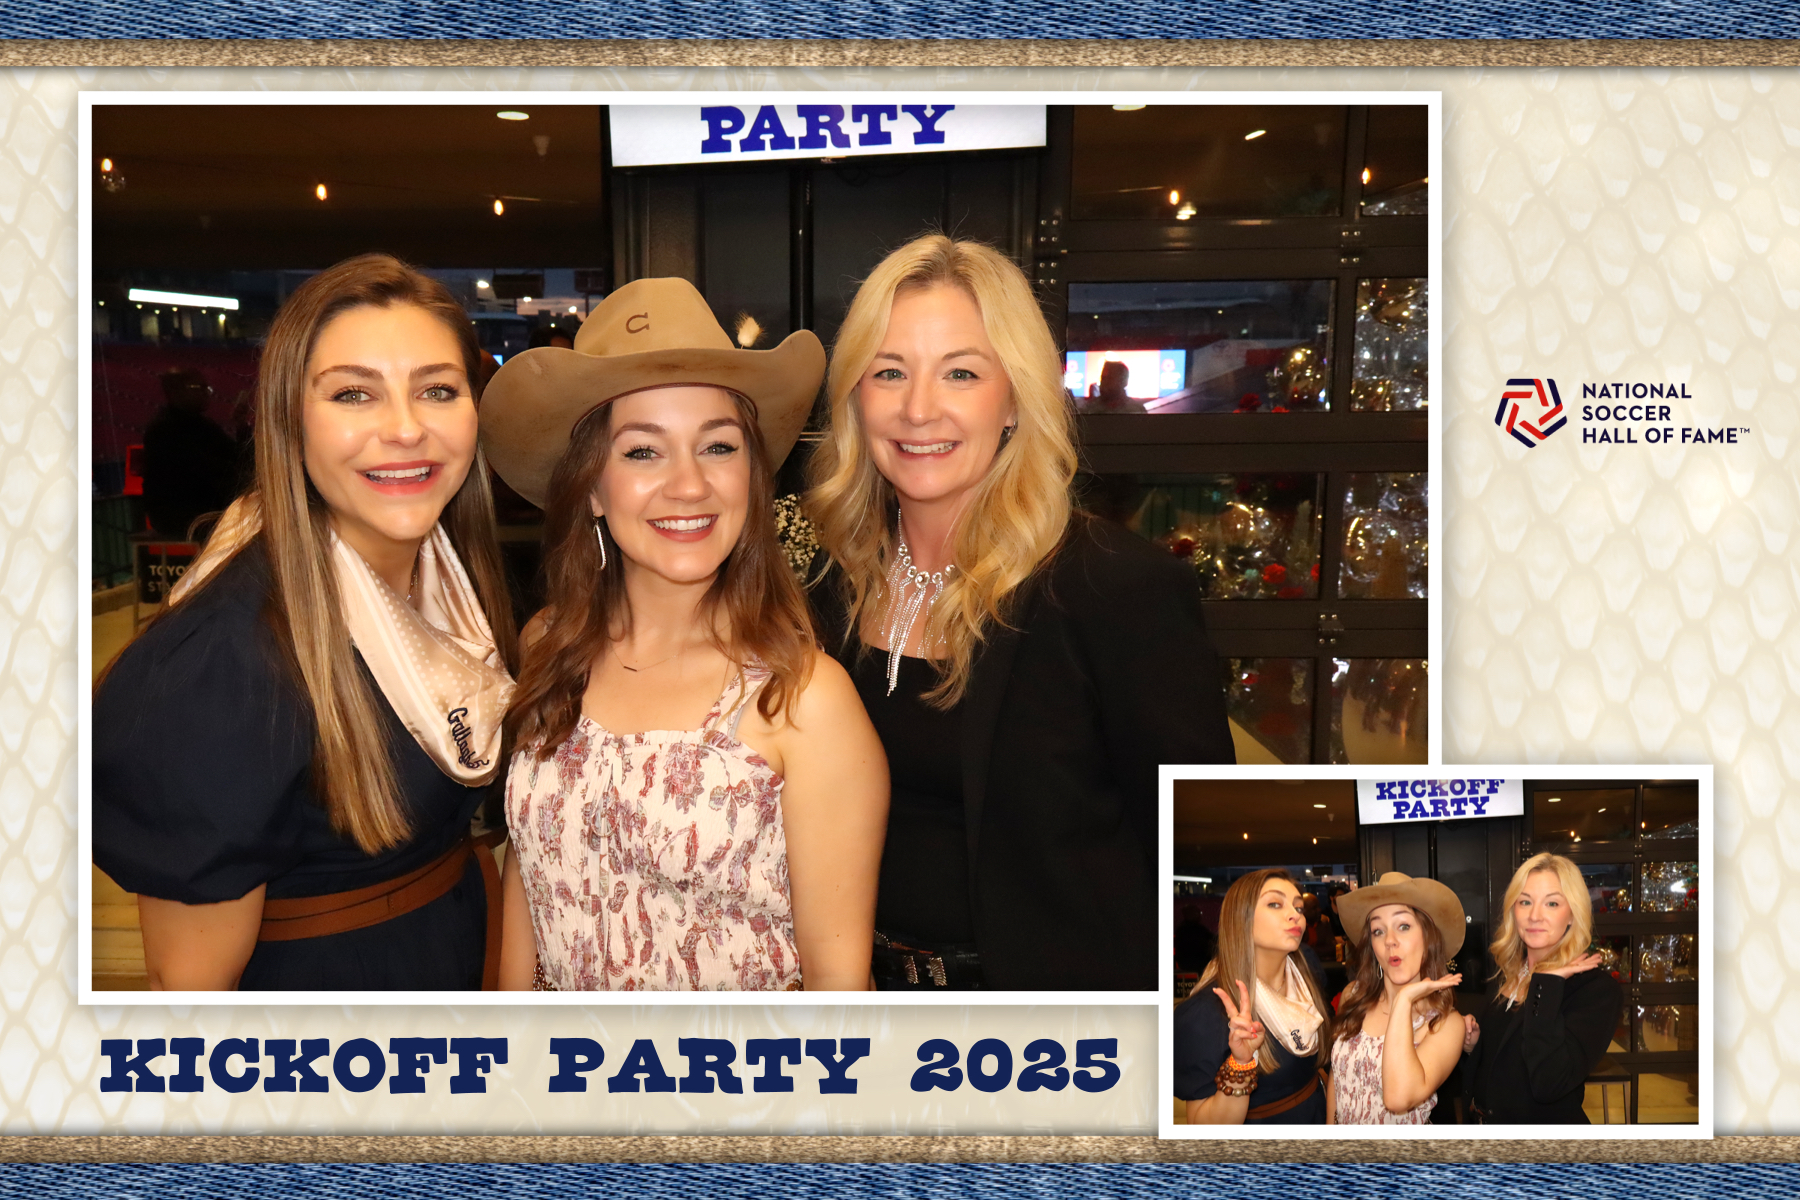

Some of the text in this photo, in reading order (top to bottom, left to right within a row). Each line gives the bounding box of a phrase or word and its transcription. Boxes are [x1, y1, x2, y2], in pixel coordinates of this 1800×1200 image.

[701, 105, 956, 154] PARTY
[148, 563, 188, 577] TOYO
[1376, 779, 1505, 800] KICKOFF
[1393, 796, 1490, 819] PARTY
